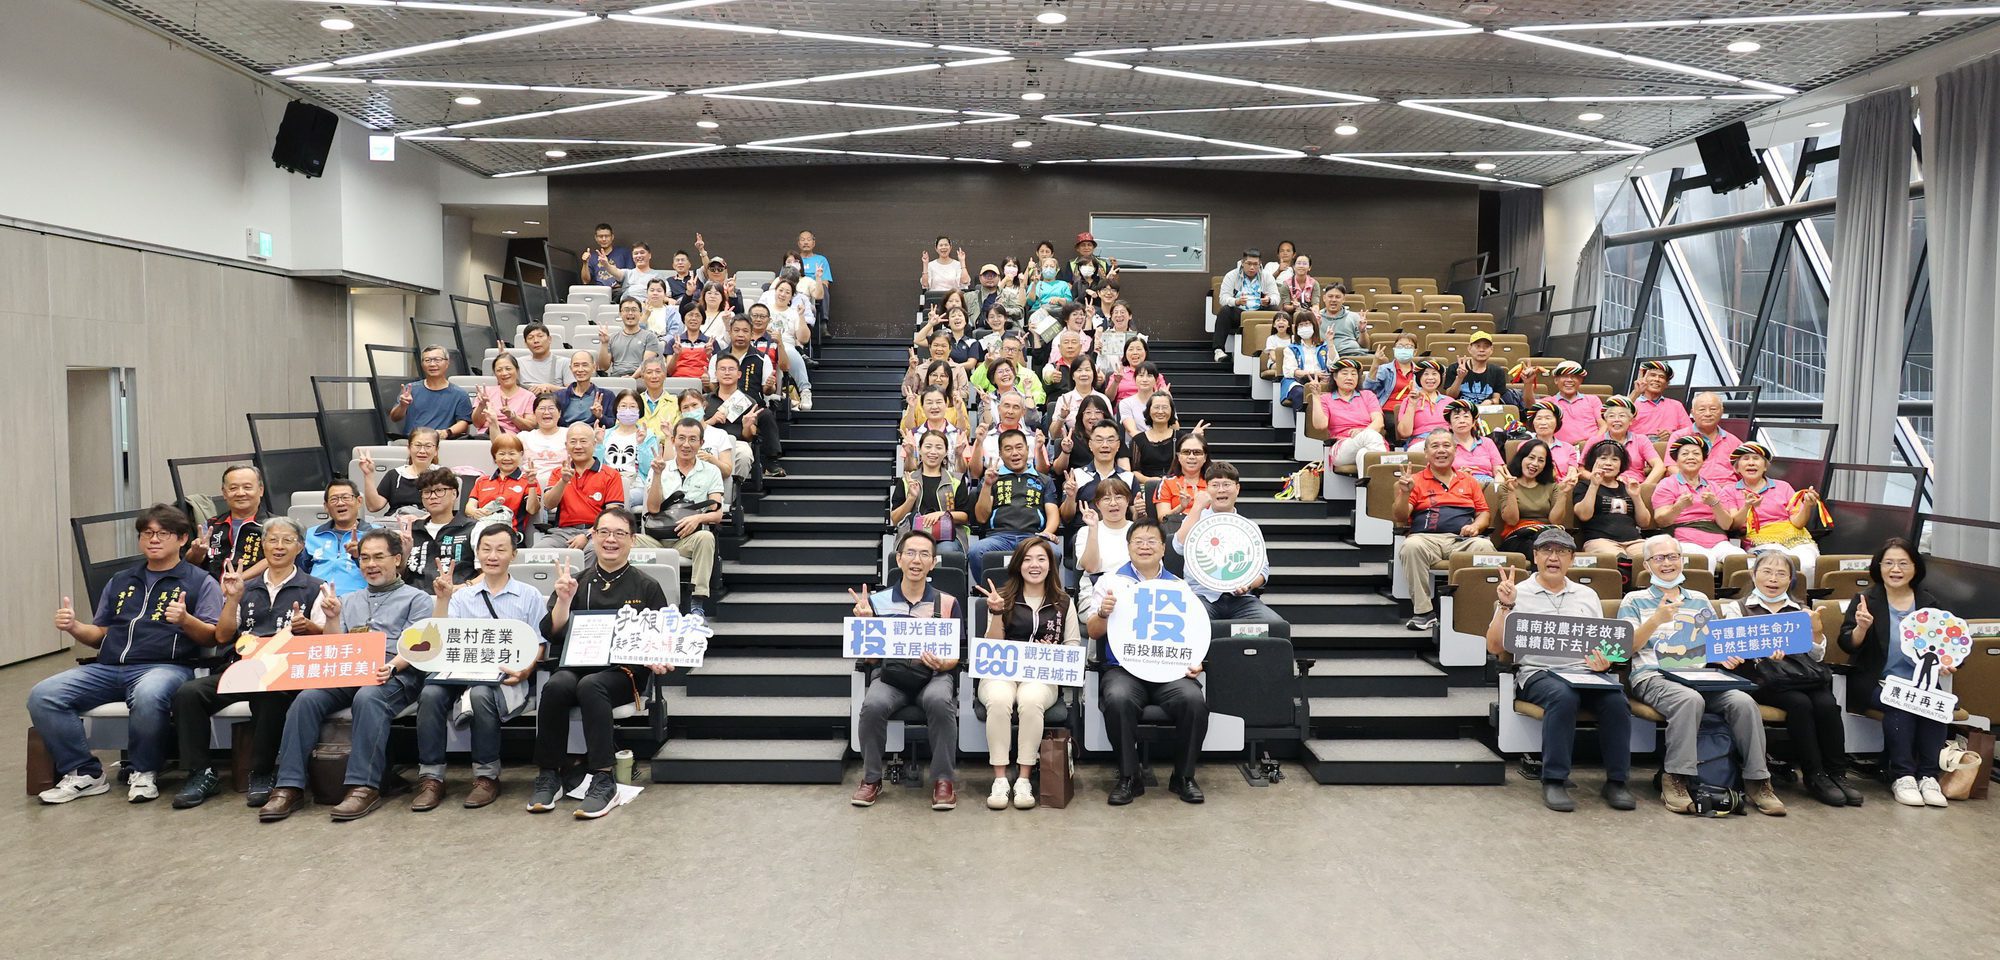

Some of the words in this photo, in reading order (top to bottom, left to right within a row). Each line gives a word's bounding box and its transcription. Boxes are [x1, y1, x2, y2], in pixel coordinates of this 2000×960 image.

[617, 608, 711, 635] 扎根南投
[1133, 588, 1186, 643] 投
[446, 627, 514, 645] 農村產業
[851, 620, 886, 656] 投
[893, 621, 953, 637] 觀光首都
[1516, 618, 1627, 640] 讓南投農村老故事
[892, 642, 953, 657] 宜居城市
[1024, 645, 1080, 663] 觀光首都
[1123, 643, 1193, 661] 南投縣政府
[1022, 665, 1079, 682] 宜居城市
[1884, 696, 1902, 706] RURAL
[1903, 703, 1949, 721] REGENERATION
[1890, 686, 1946, 713] 農村再生
